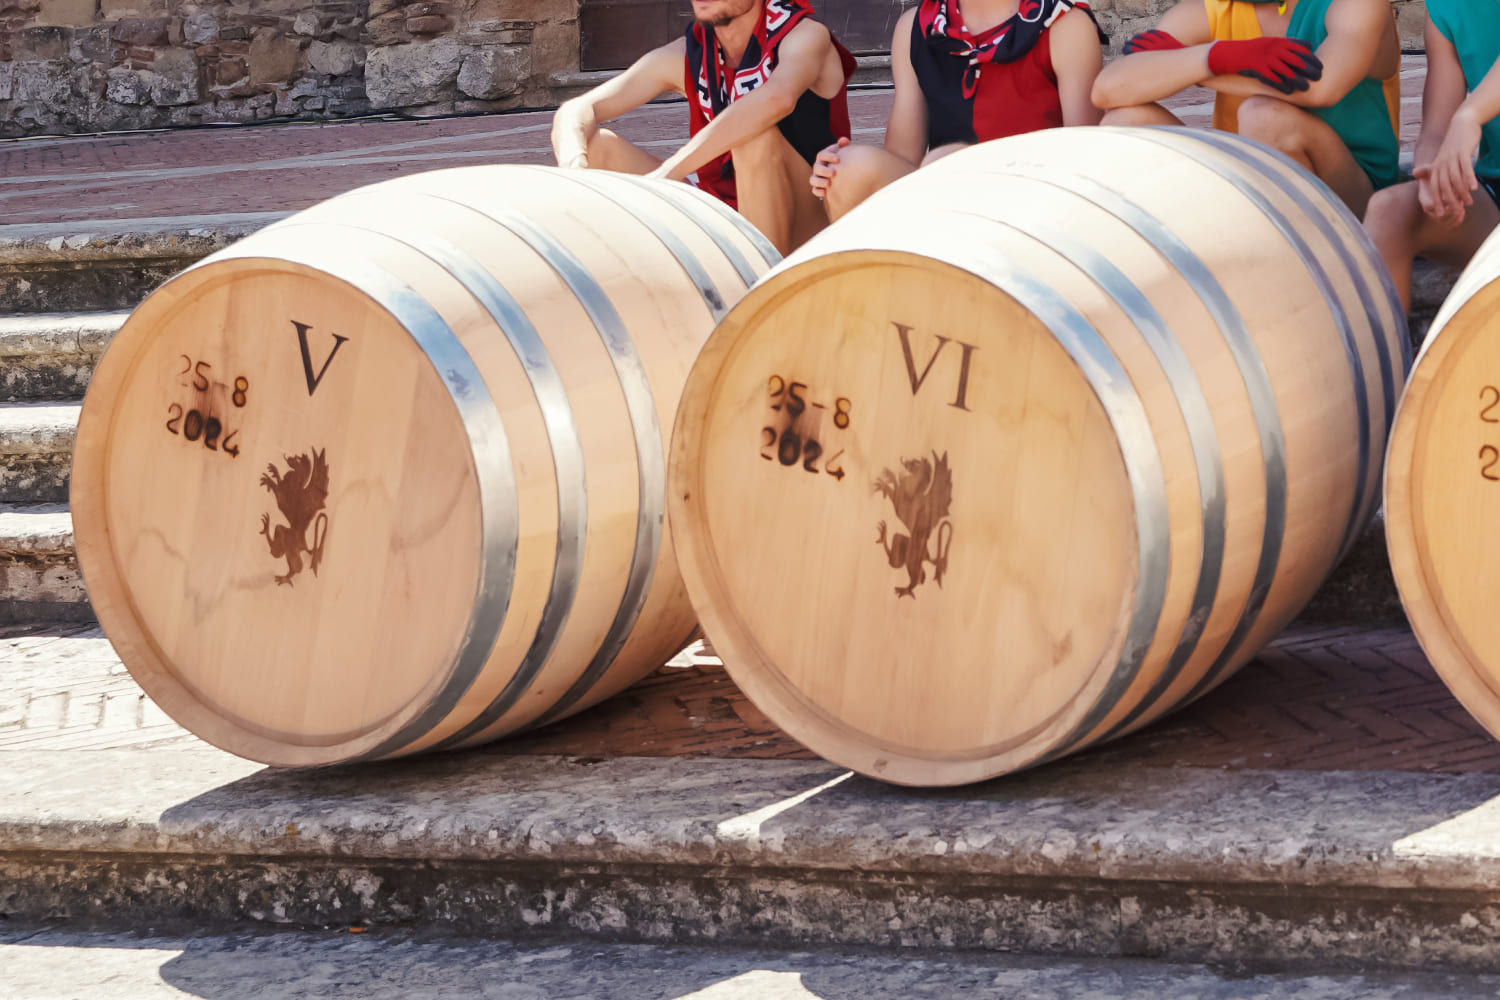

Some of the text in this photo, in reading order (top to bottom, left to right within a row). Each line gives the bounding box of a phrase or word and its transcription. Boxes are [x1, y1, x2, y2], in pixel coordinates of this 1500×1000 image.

[290, 319, 349, 397] V
[890, 321, 982, 413] VI
[166, 402, 240, 459] 2024
[760, 426, 845, 482] 2024
